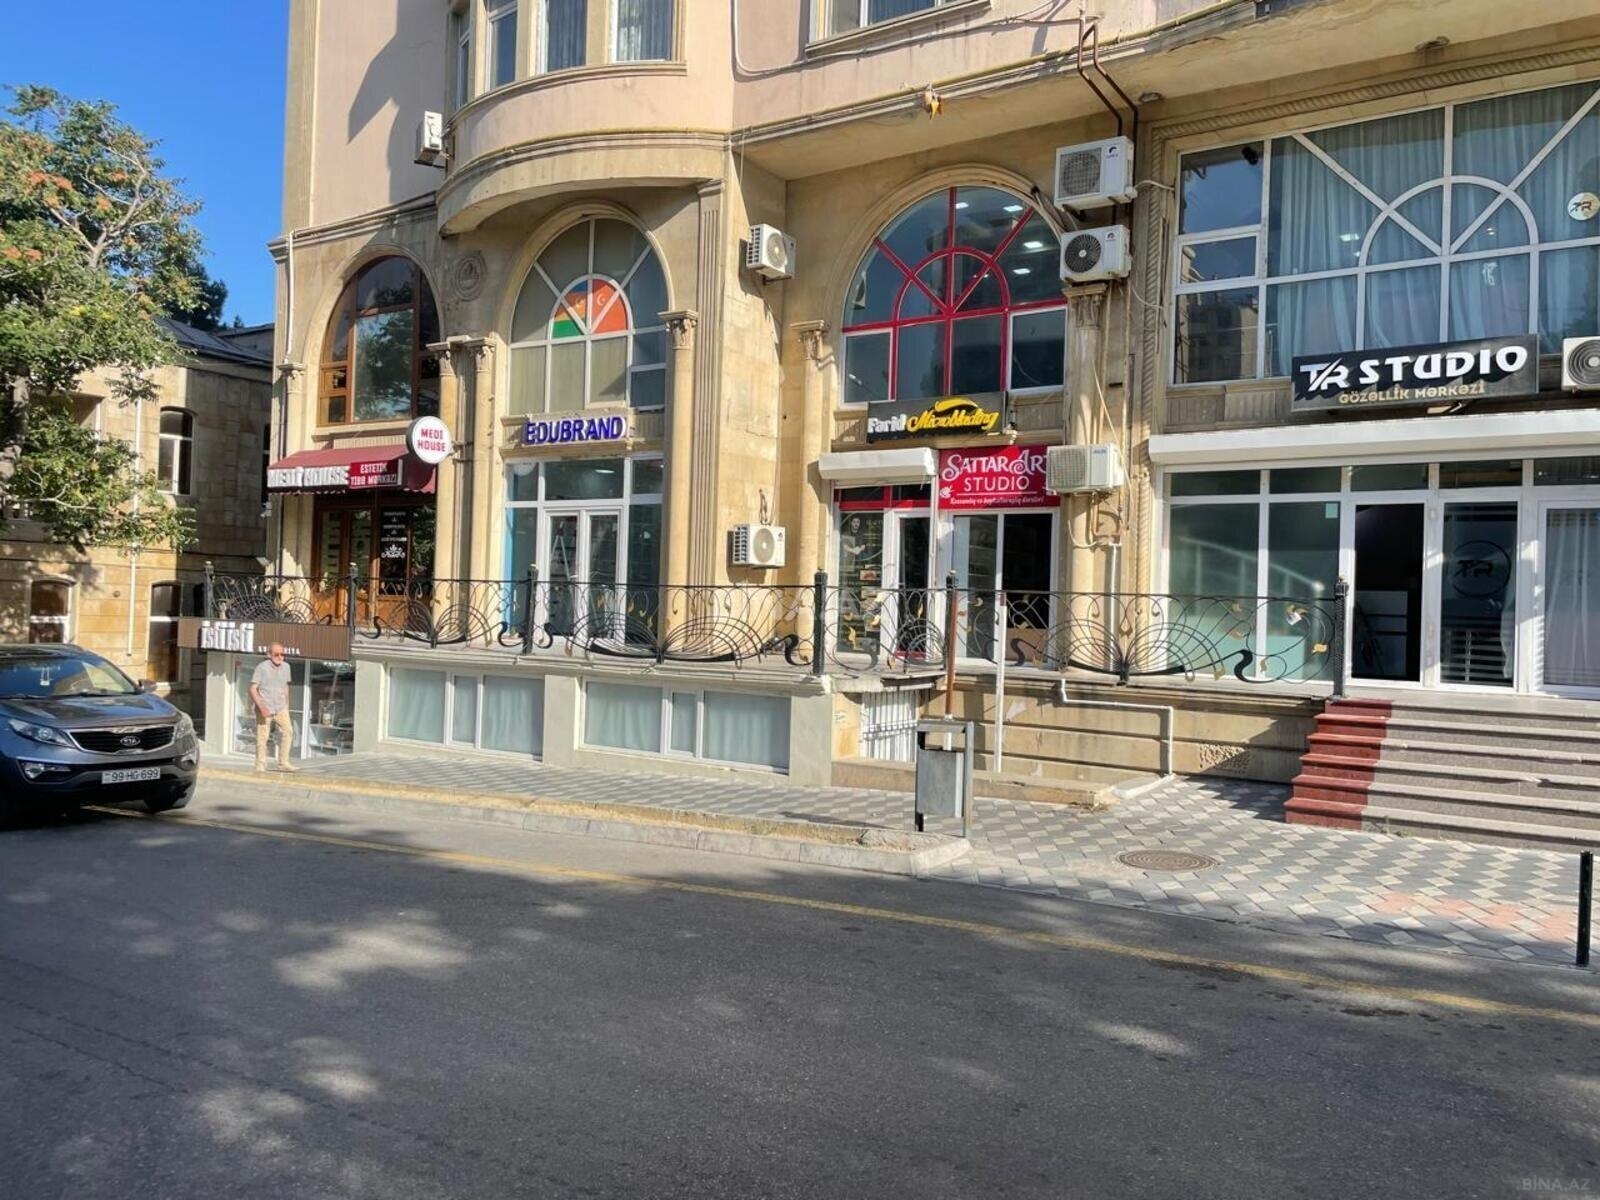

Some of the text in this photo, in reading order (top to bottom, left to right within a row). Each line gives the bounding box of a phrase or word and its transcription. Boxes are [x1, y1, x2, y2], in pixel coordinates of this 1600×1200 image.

[1359, 345, 1528, 385] STUDIO
[524, 415, 626, 445] EDUBRAND
[867, 414, 907, 433] Farid
[417, 440, 446, 452] HOUSE
[1009, 449, 1048, 475] AR
[964, 475, 1030, 492] STUDIO
